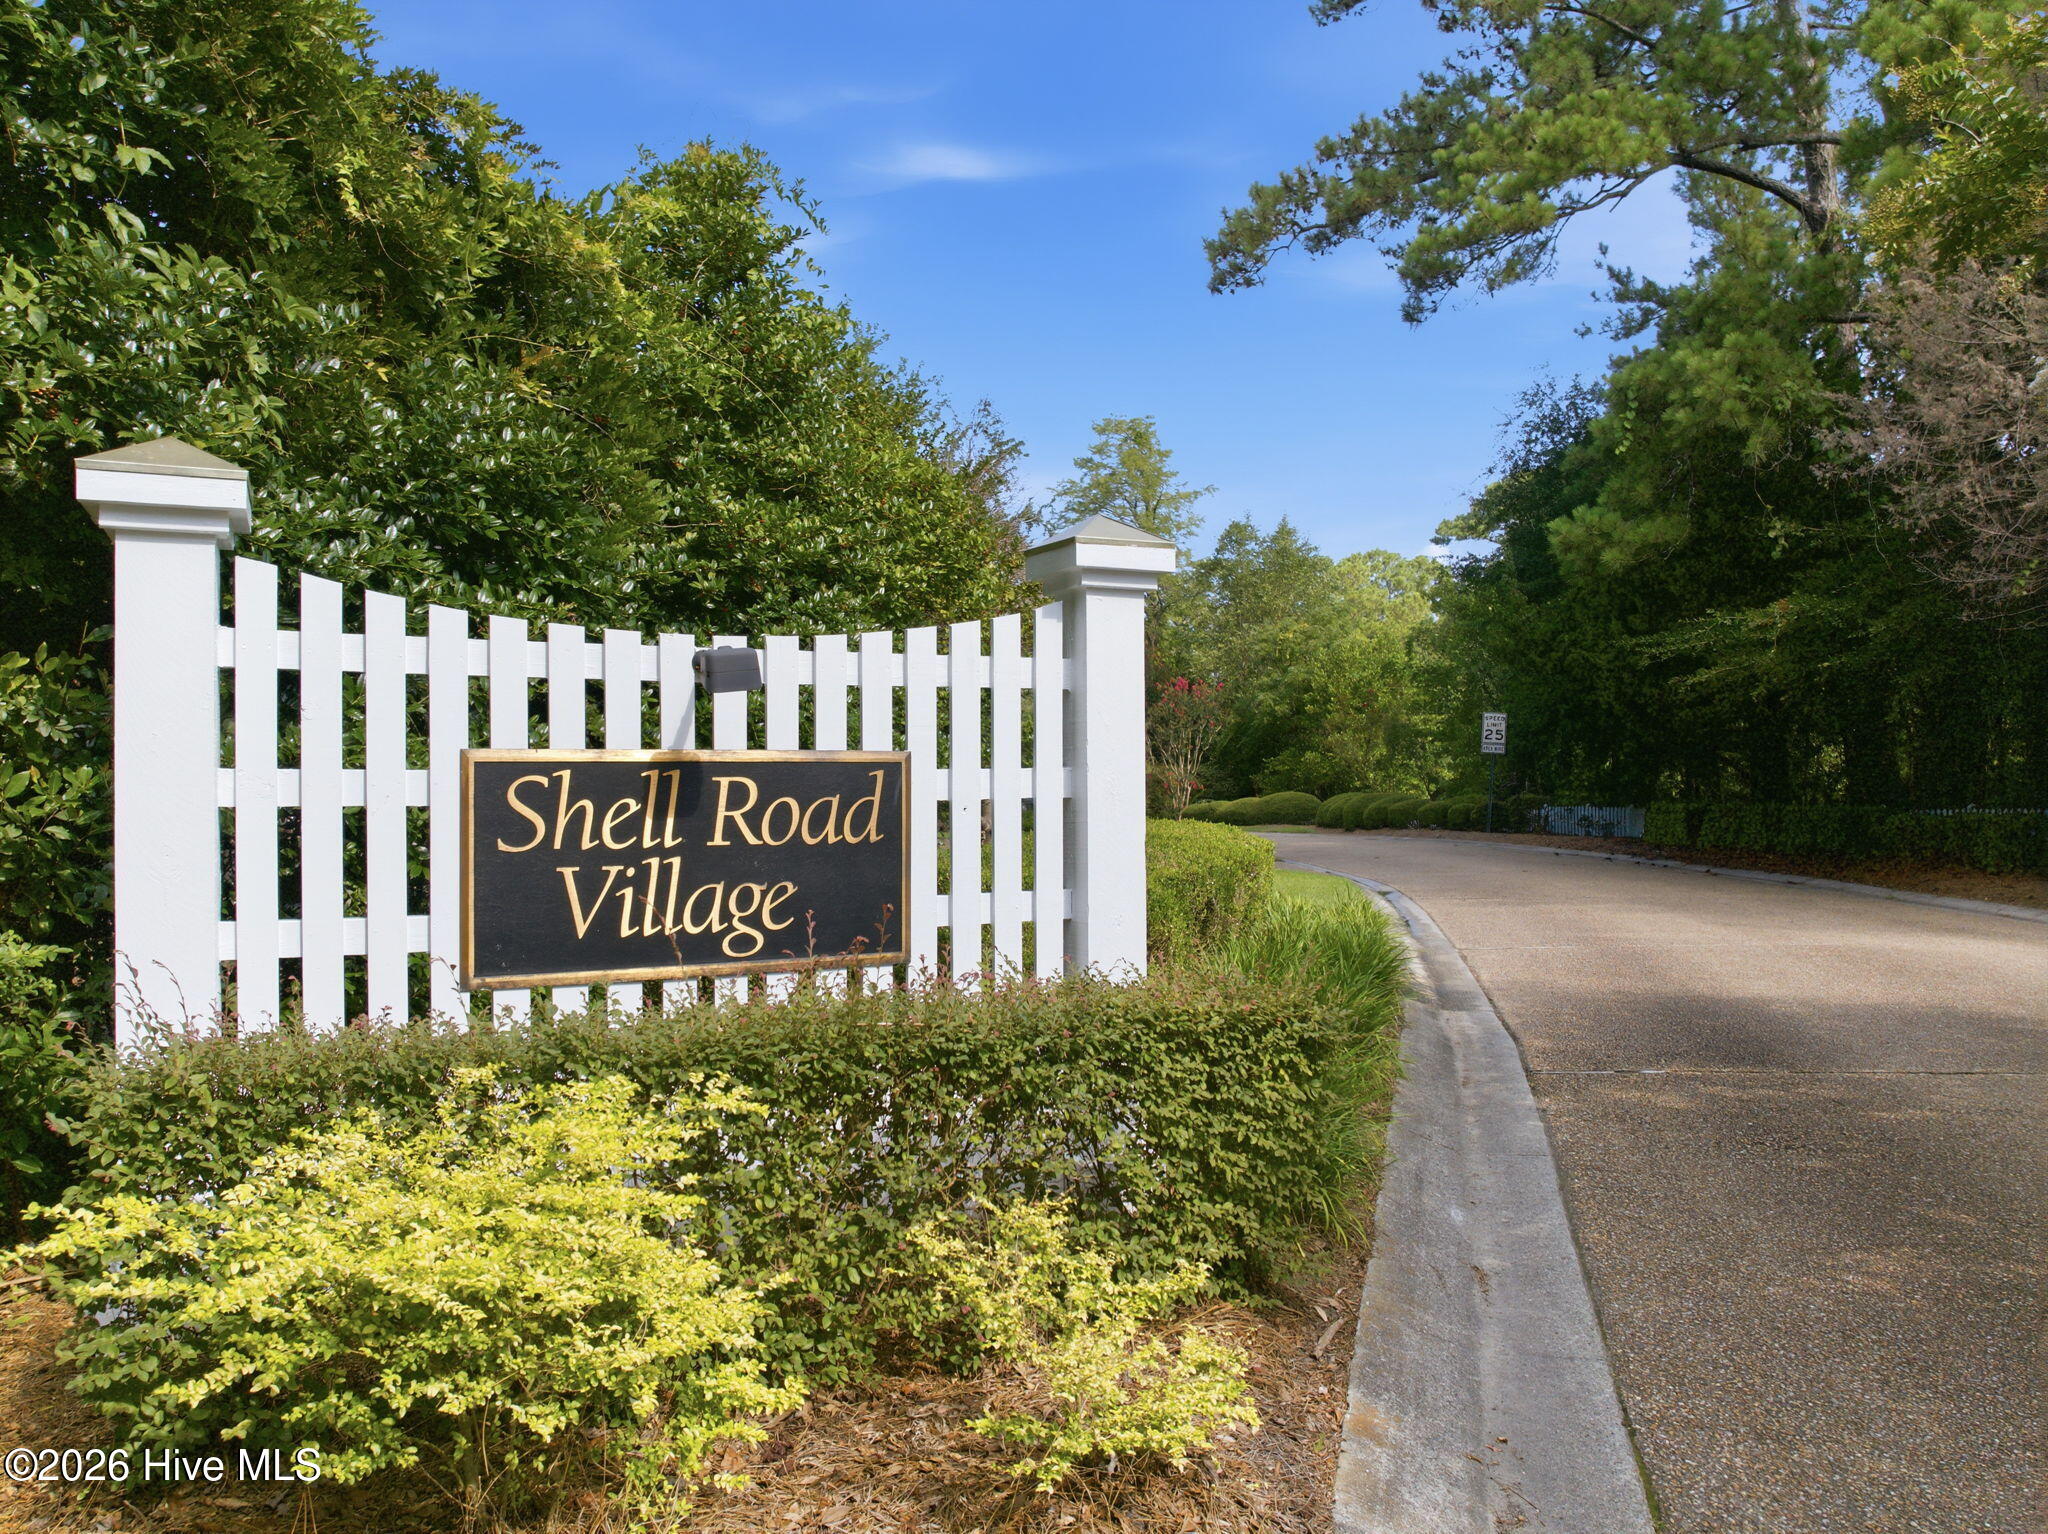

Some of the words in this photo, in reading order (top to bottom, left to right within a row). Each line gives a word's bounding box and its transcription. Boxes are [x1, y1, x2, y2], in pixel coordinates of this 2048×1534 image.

[1485, 729, 1503, 740] 25
[497, 769, 683, 853] Shell
[706, 769, 885, 847] Road
[556, 856, 798, 958] Village
